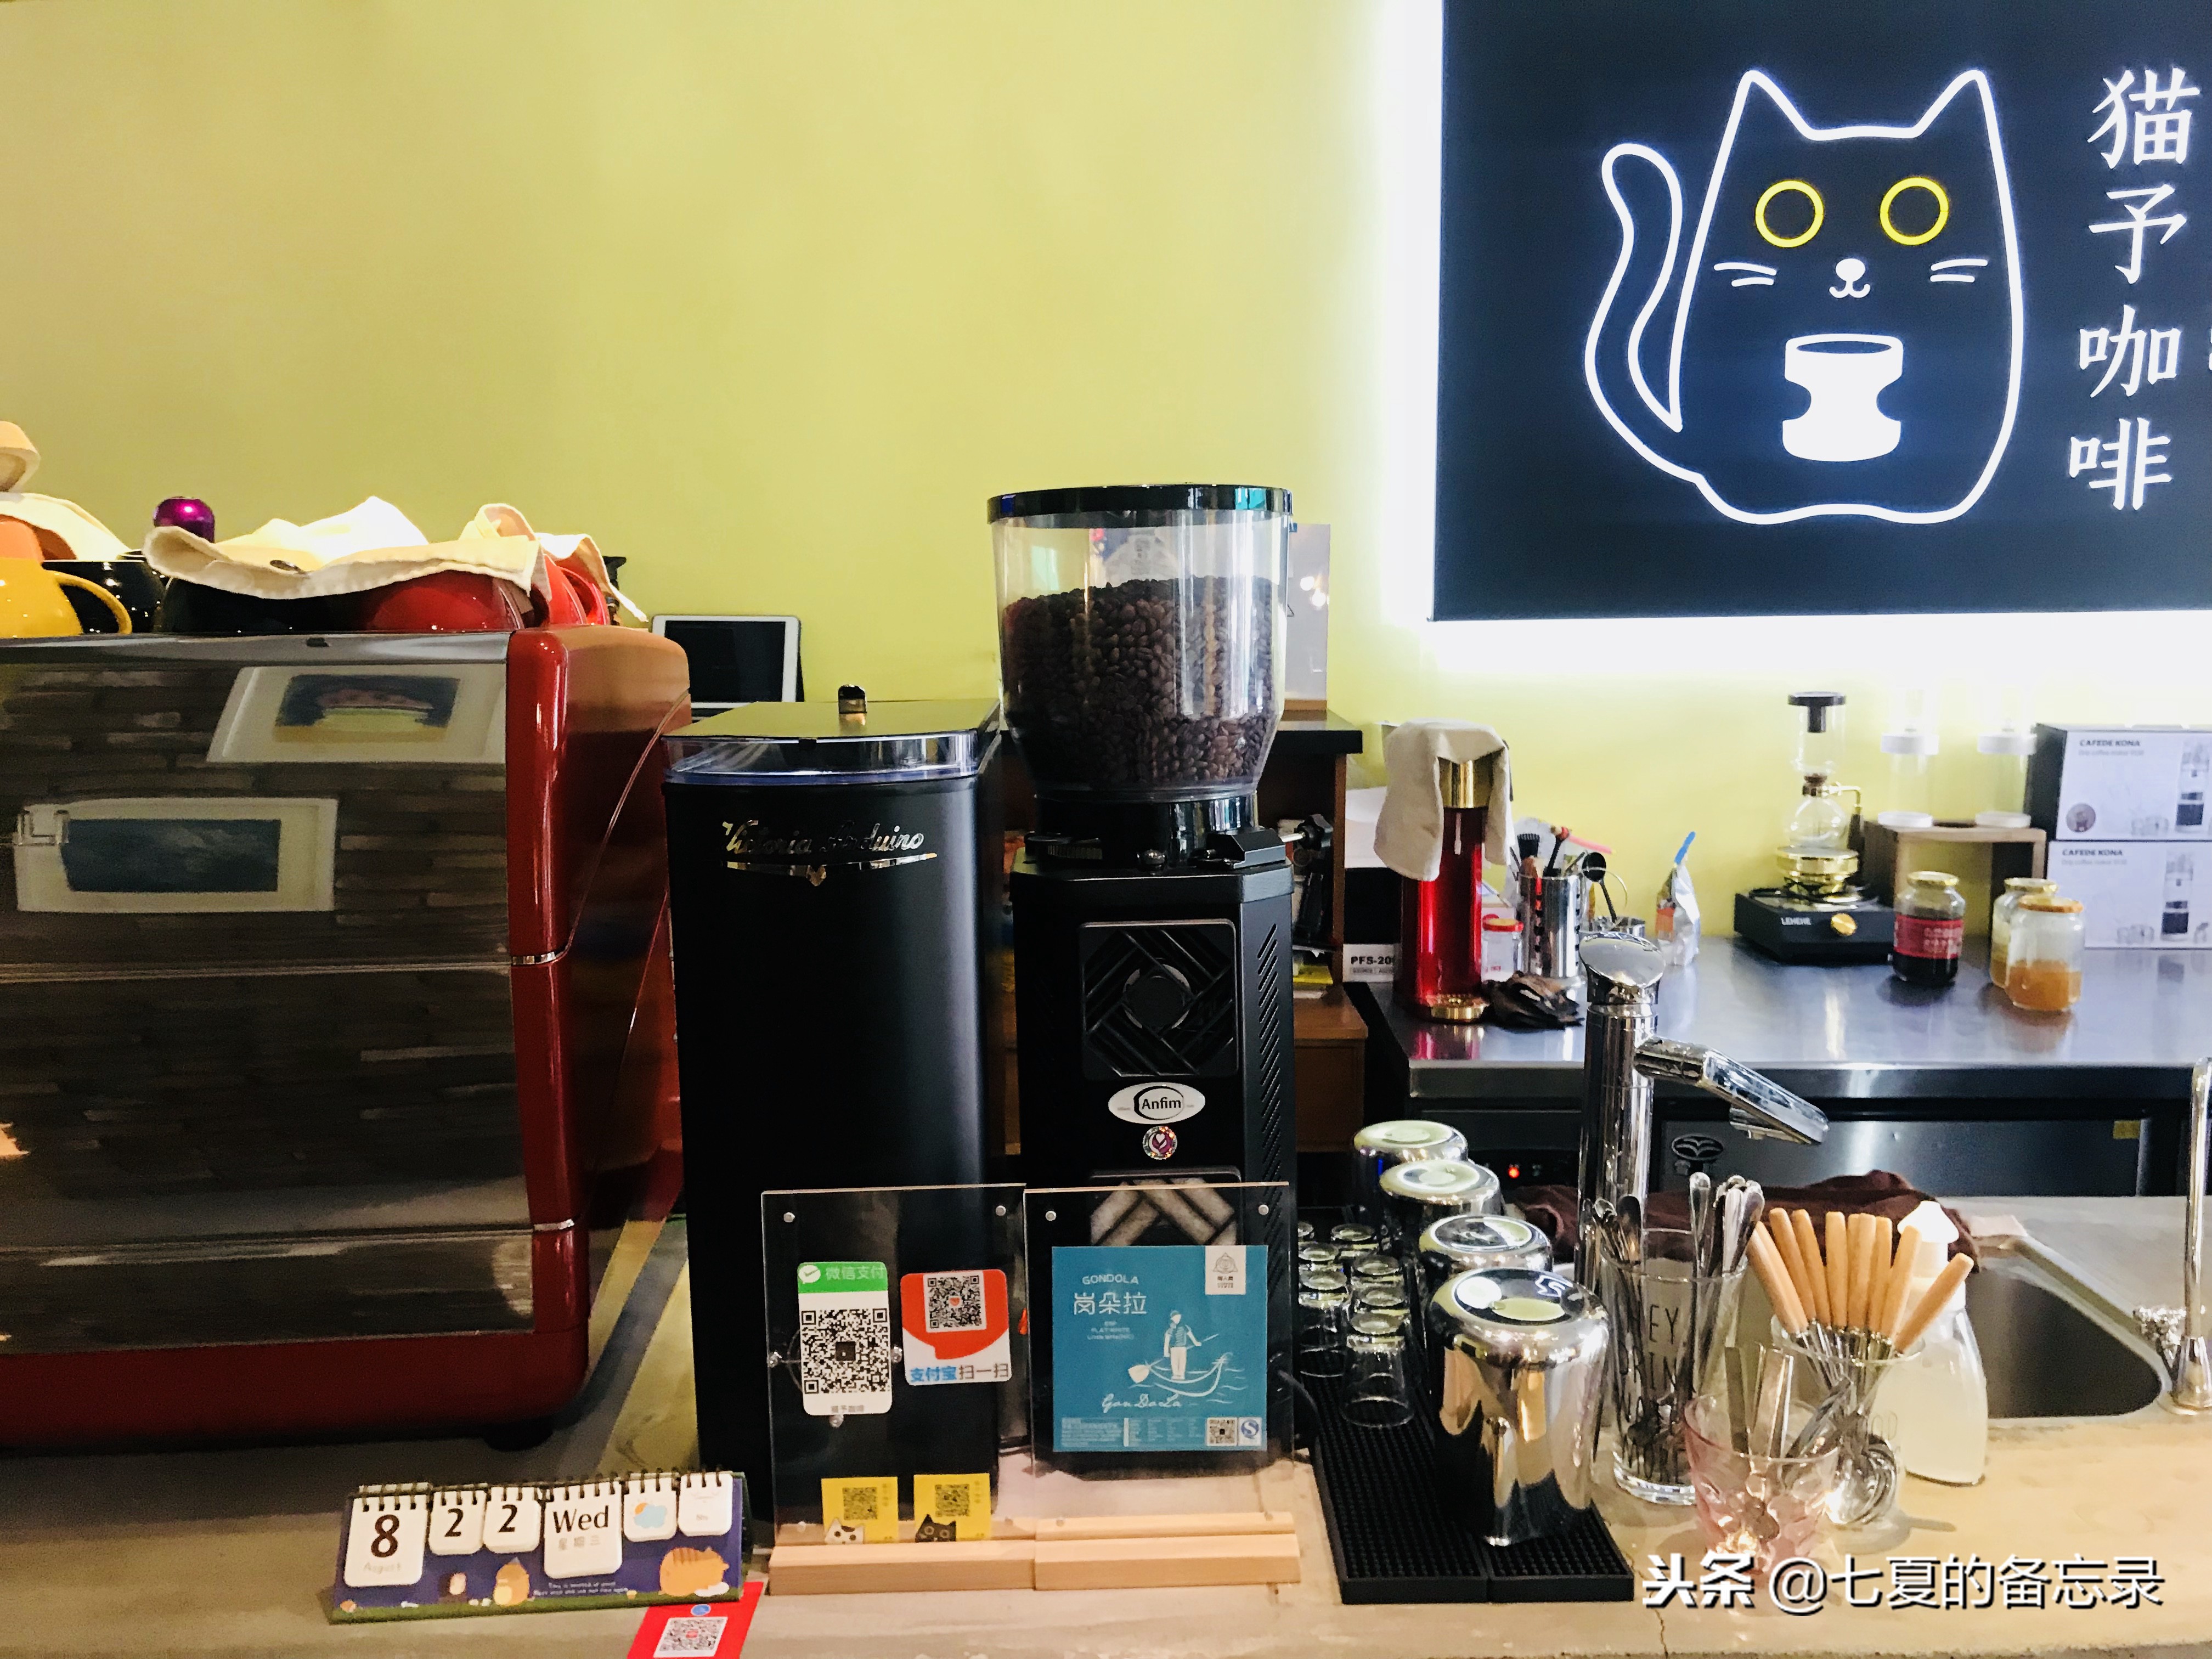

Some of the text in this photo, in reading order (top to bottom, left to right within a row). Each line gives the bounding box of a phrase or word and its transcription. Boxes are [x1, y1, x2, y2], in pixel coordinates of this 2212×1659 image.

[2069, 64, 2200, 511] 猫予咖啡
[1142, 1097, 1181, 1110] Anfim
[825, 1266, 885, 1281] 微信支付
[1082, 1274, 1139, 1285] GONDOLA
[1074, 1291, 1147, 1315] 岗朵拉
[910, 1362, 1009, 1383] 支付宝扫一扫
[371, 1504, 609, 1558] 8 2 2 Wed
